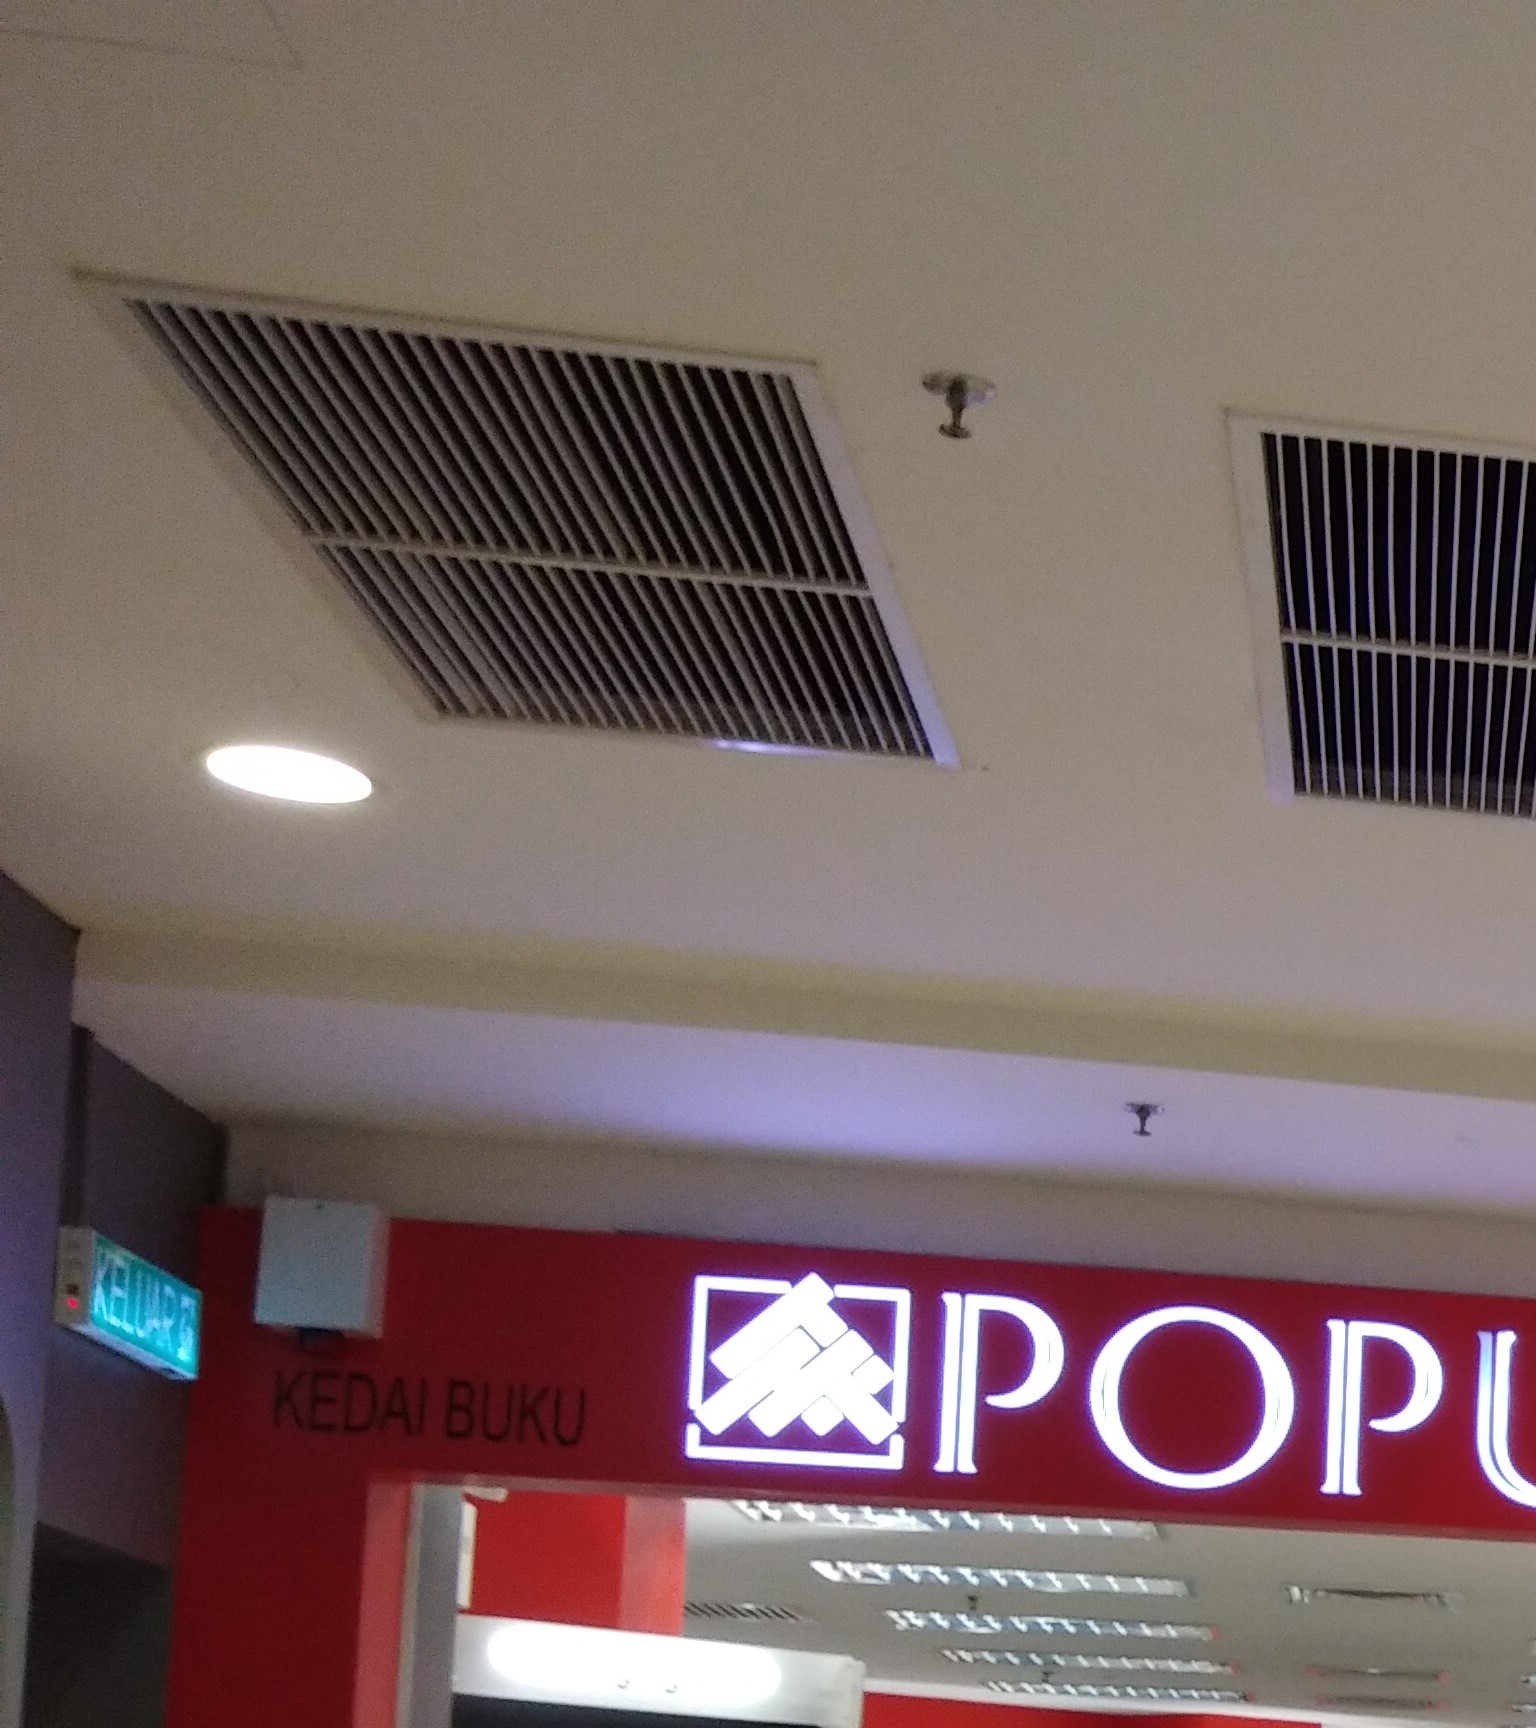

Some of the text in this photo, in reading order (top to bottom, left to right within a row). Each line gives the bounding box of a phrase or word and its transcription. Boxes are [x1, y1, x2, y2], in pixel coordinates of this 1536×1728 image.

[92, 1250, 176, 1352] KELUAR
[271, 1371, 586, 1447] KEDAI BUKU
